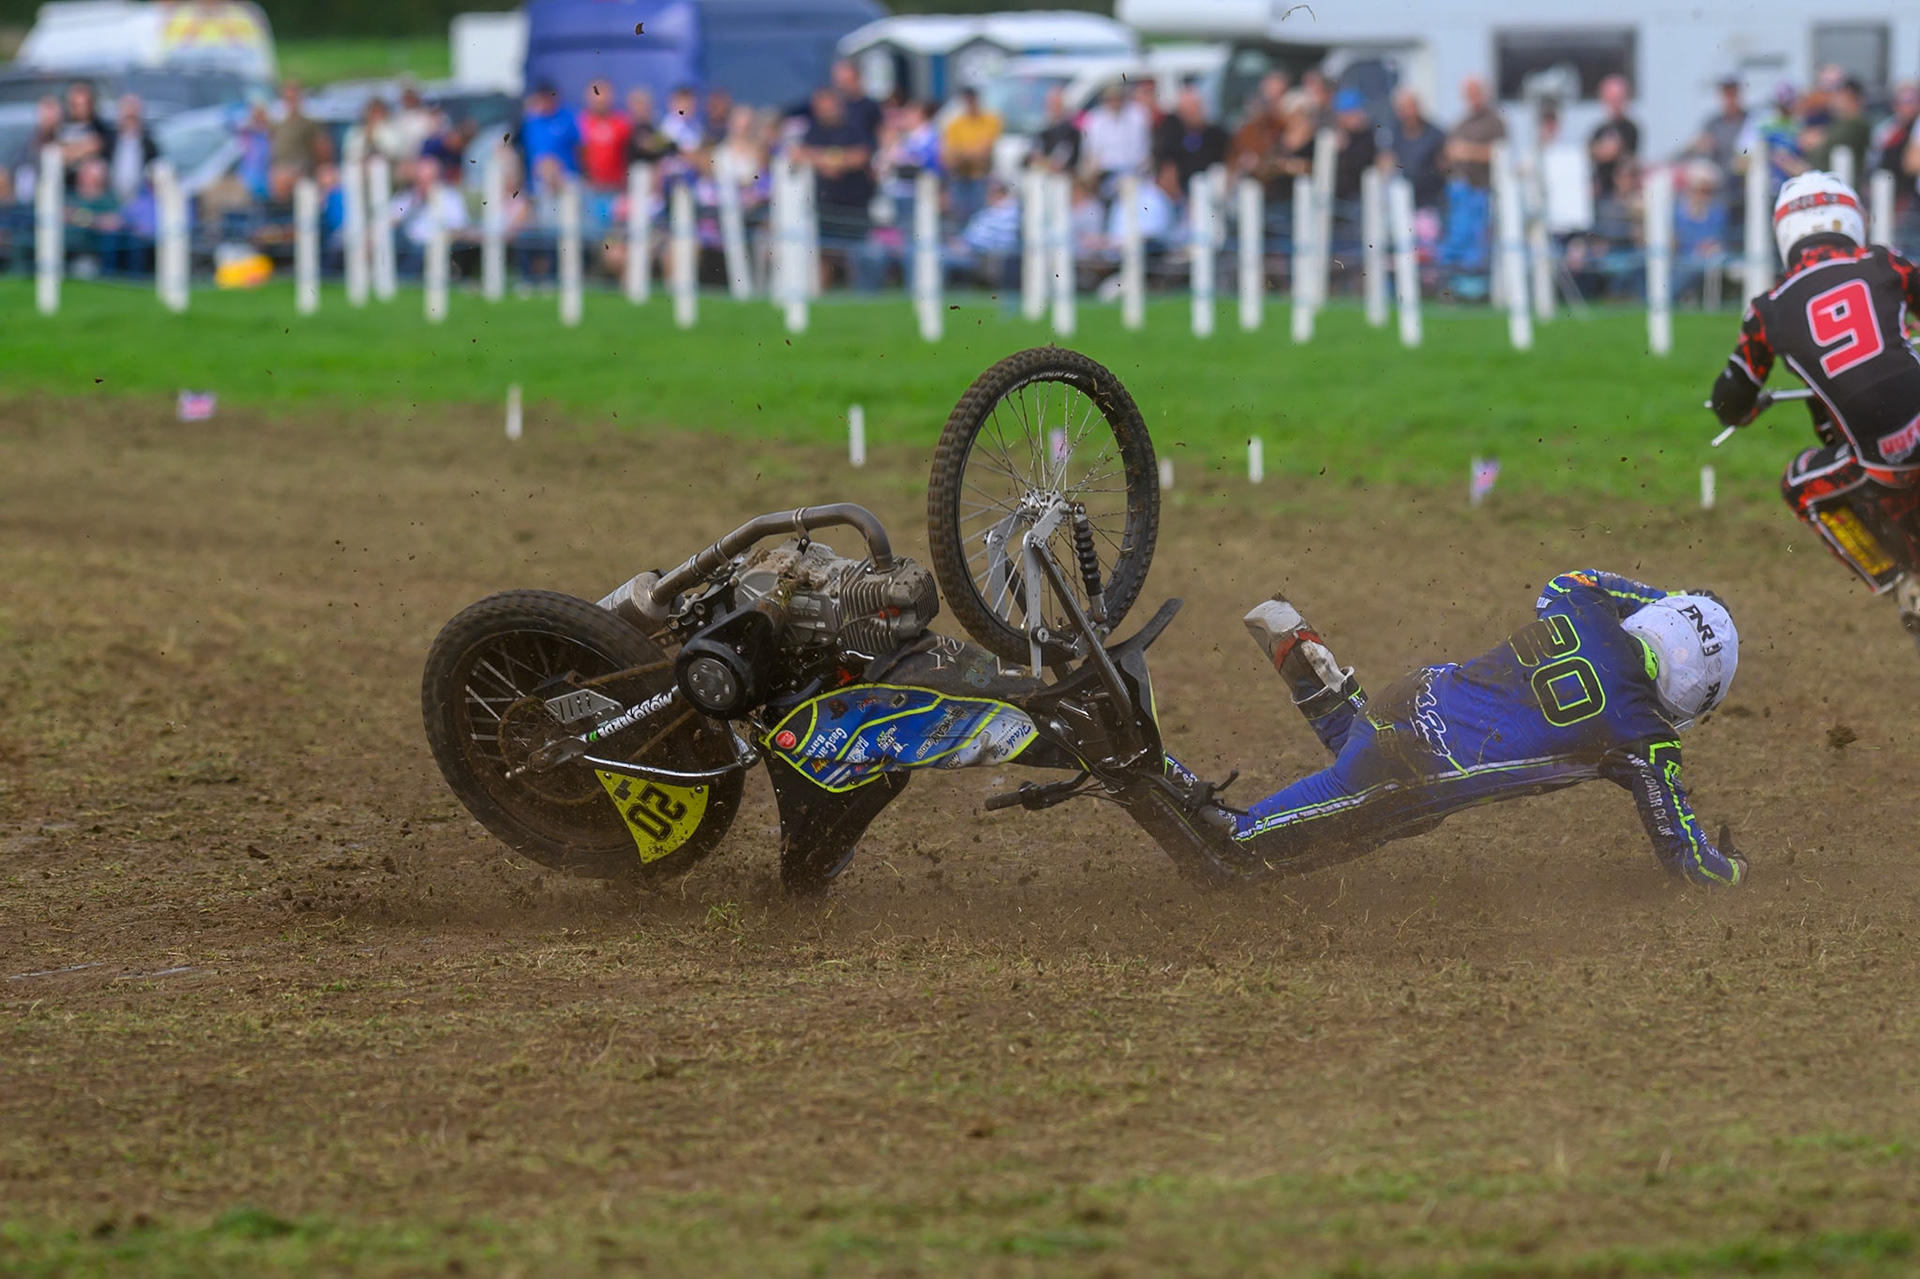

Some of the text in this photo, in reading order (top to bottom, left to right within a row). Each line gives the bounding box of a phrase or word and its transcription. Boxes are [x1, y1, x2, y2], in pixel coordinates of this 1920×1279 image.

[1806, 278, 1885, 380] 9
[1507, 613, 1606, 727] 20
[597, 692, 673, 738] MOTOVERDE
[914, 717, 952, 760] HEALY GROUP
[1005, 720, 1032, 749] Flash
[626, 783, 688, 841] 20
